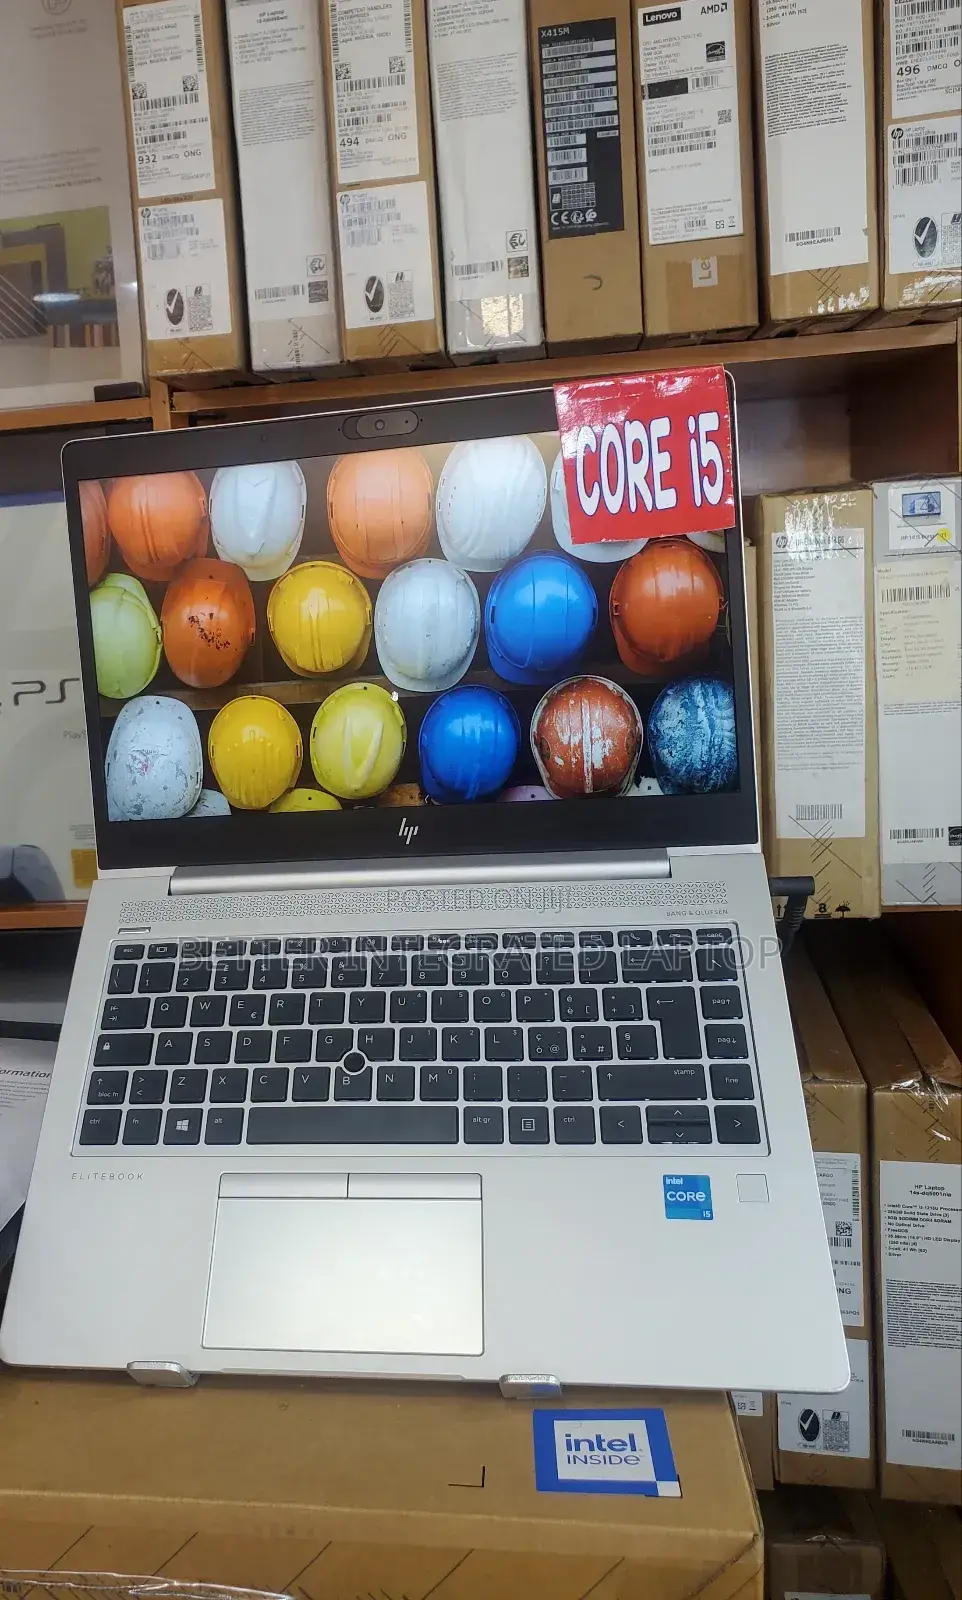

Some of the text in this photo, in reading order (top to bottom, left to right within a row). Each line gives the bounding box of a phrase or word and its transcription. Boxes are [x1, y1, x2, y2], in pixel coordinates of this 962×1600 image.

[700, 4, 720, 15] AMD
[645, 11, 678, 23] Lenovo
[541, 27, 570, 38] X415M
[896, 63, 948, 76] 496 DMCQ
[339, 137, 360, 148] 494
[387, 132, 407, 141] ONG
[138, 154, 157, 164] 932
[183, 149, 202, 158] ONG
[576, 411, 725, 516] CORE i5
[398, 817, 419, 845] hp
[818, 902, 827, 913] 8
[260, 963, 267, 972] $
[259, 975, 266, 983] 4
[460, 971, 467, 979] 9
[183, 978, 189, 986] 2
[220, 977, 227, 985] 3
[237, 1000, 245, 1009] E
[276, 999, 285, 1008] R
[316, 998, 323, 1007] T
[357, 997, 365, 1006] Y
[398, 997, 406, 1006] U
[482, 996, 491, 1005] O
[524, 996, 532, 1004] P
[160, 1002, 169, 1011] Q
[199, 1001, 212, 1010] W
[250, 1011, 258, 1019] €
[204, 1038, 211, 1047] S
[243, 1037, 252, 1046] D
[283, 1036, 291, 1045] F
[324, 1035, 333, 1044] G
[365, 1035, 374, 1043] H
[407, 1035, 414, 1044] J
[450, 1034, 458, 1043] K
[493, 1034, 500, 1043] L
[164, 1039, 173, 1048] A
[550, 1045, 560, 1053] @
[597, 1045, 605, 1053] #
[178, 1077, 186, 1086] Z
[218, 1076, 227, 1085] X
[259, 1075, 268, 1084] C
[301, 1075, 310, 1084] V
[342, 1076, 351, 1085] B
[385, 1074, 394, 1082] N
[428, 1074, 438, 1082] M
[71, 1172, 144, 1181] ELITEBOOK
[665, 1176, 684, 1185] intel
[702, 1210, 711, 1218] i5
[836, 1287, 852, 1295] NG
[565, 1433, 637, 1452] intel
[567, 1454, 640, 1466] INSIDE
